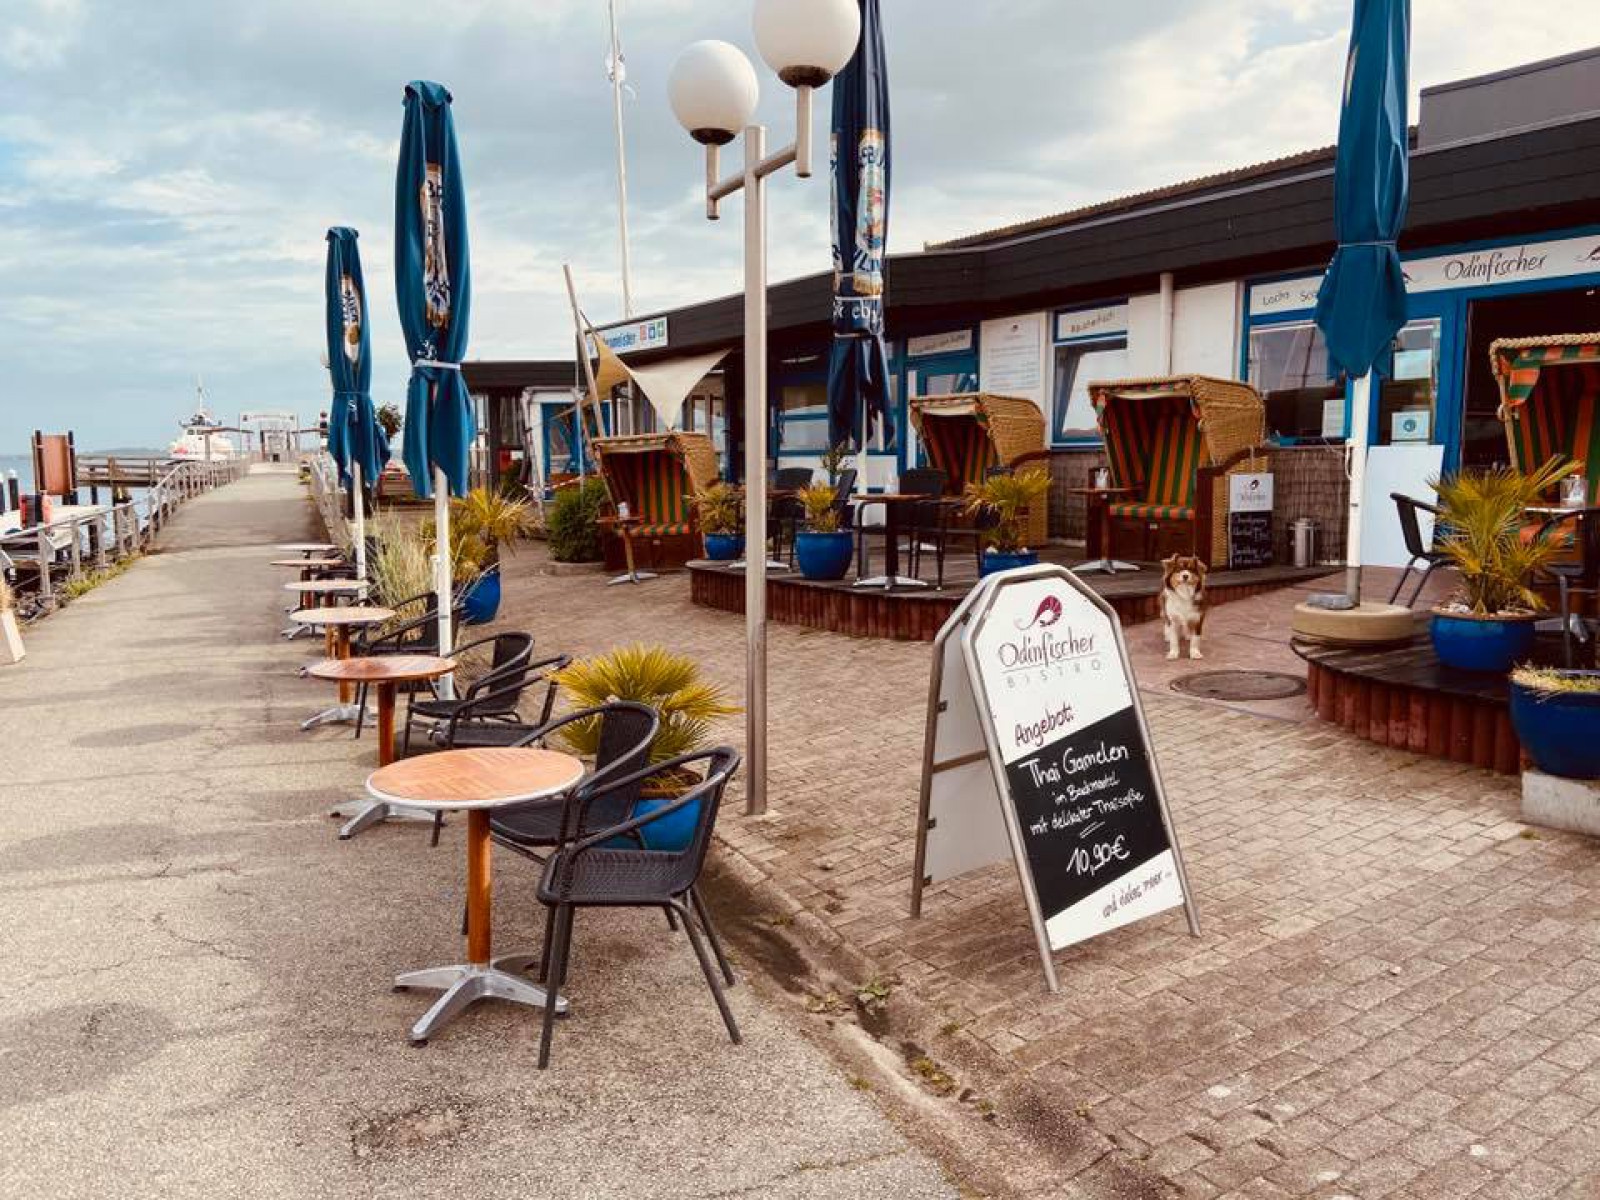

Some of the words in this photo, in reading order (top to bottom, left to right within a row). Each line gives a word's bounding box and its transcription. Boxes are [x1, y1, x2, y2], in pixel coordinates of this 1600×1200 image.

[1444, 245, 1548, 283] Odinfischer
[998, 626, 1095, 668] Odinfischer
[1006, 659, 1101, 689] BISTRO
[1014, 702, 1075, 748] Angebot:
[1018, 757, 1061, 788] Thai
[1029, 815, 1049, 836] mit
[1066, 834, 1131, 877] 10,90€
